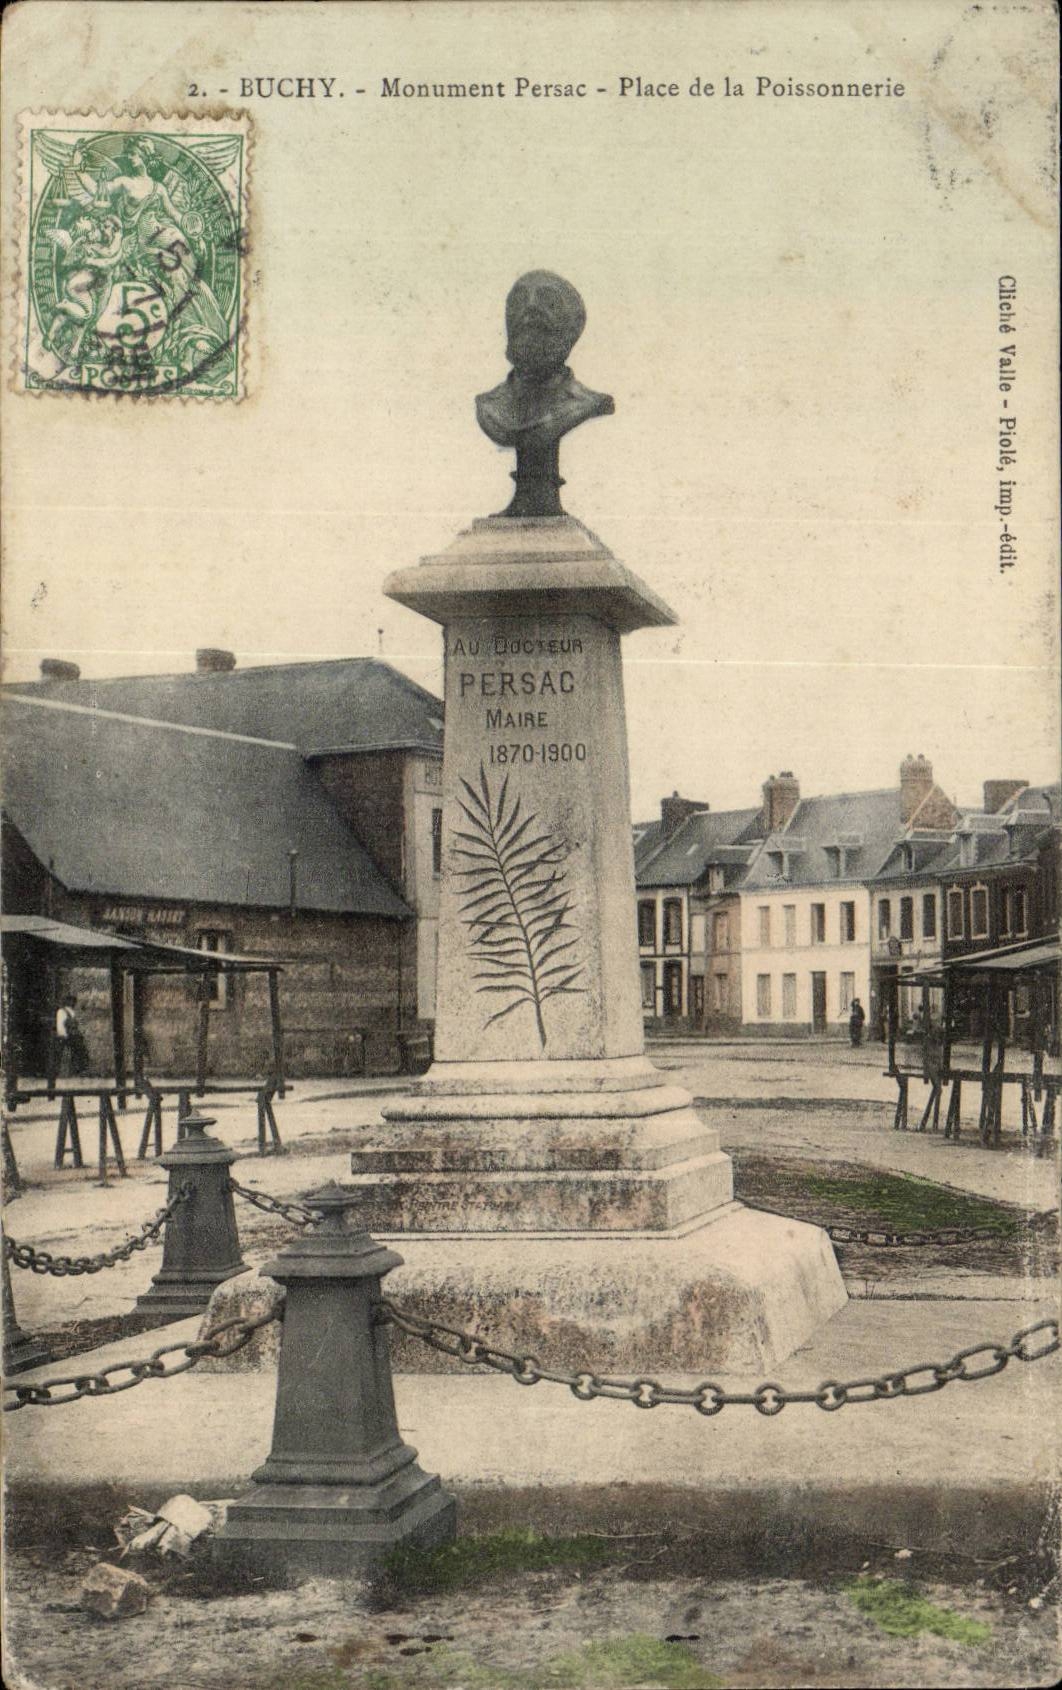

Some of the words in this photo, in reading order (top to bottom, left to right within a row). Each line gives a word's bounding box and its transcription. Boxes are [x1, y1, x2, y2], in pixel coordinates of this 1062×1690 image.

[453, 637, 480, 656] AU
[460, 671, 575, 697] PERSAC
[486, 709, 549, 730] MAIRE
[490, 743, 586, 764] 1870-1900
